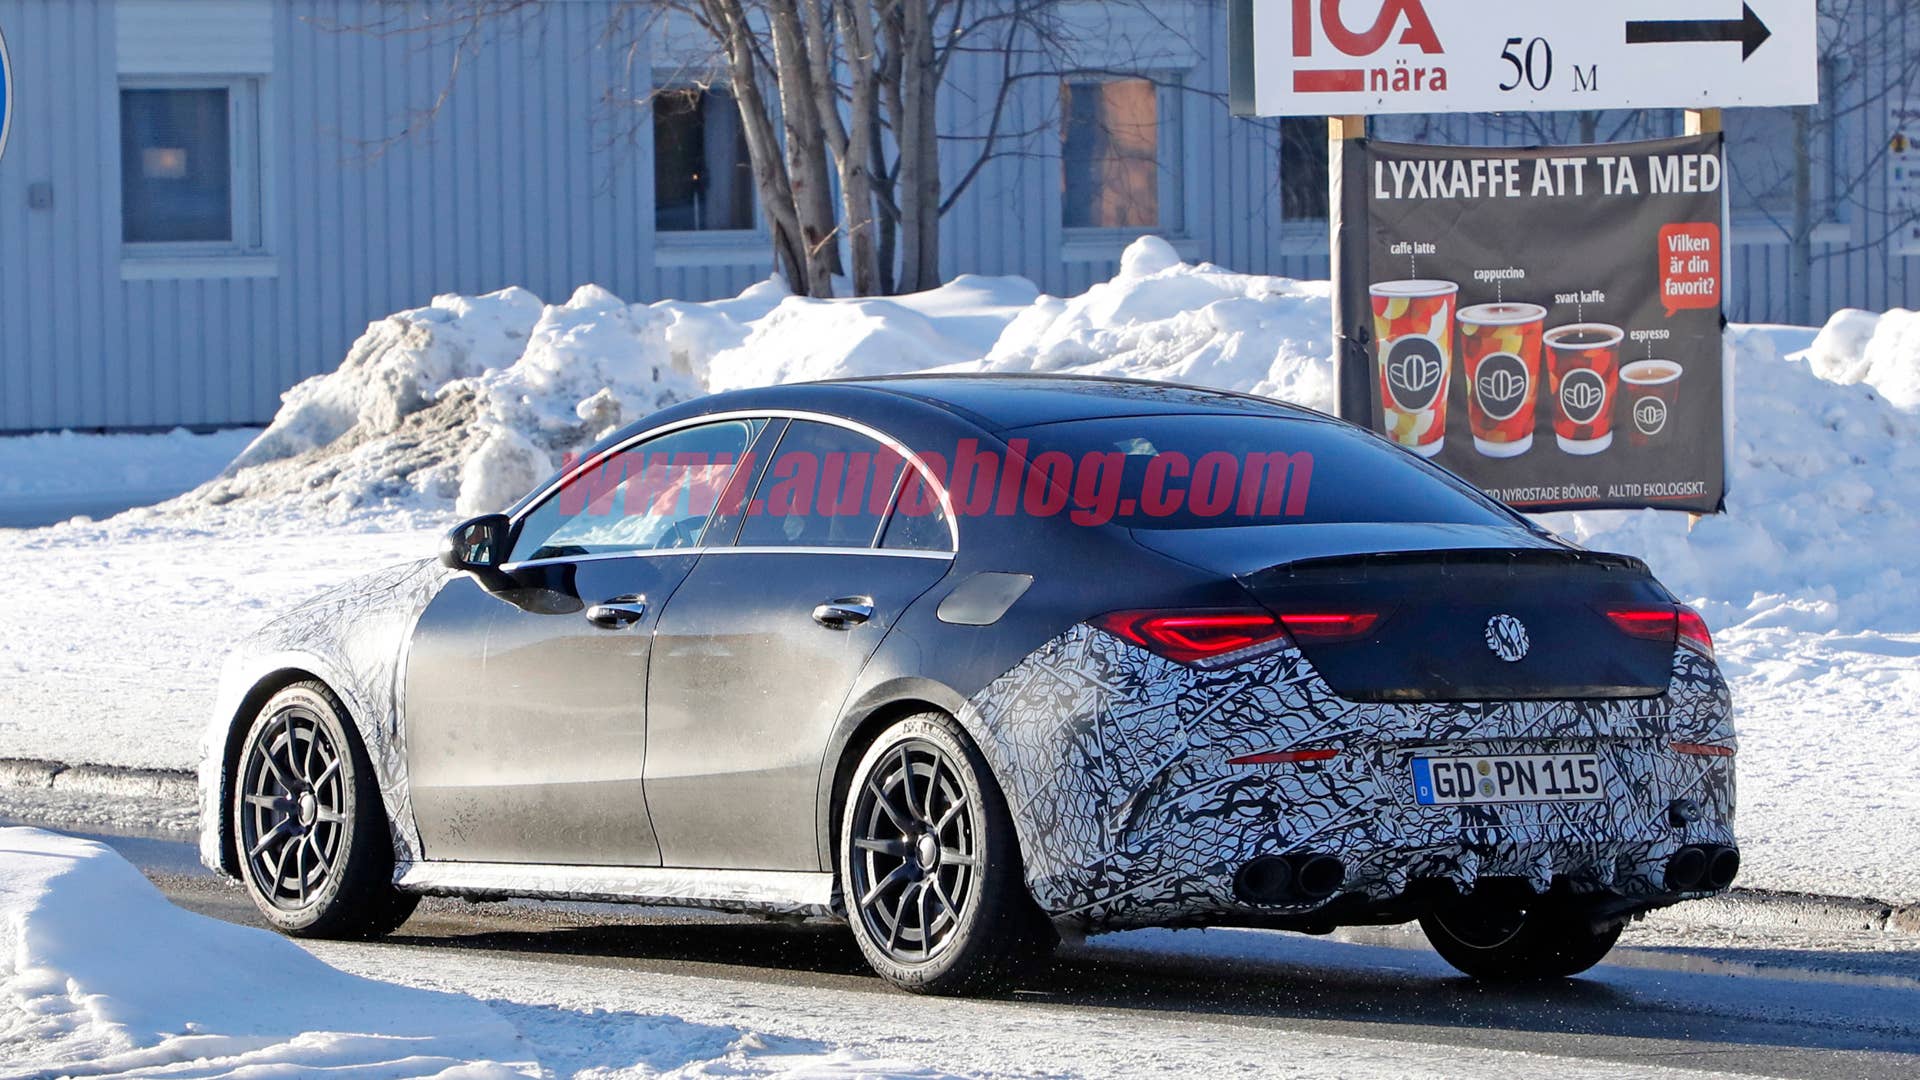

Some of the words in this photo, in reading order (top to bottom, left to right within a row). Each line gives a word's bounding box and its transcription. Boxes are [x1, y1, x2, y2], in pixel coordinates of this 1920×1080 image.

[1292, 0, 1445, 57] ICA
[1499, 37, 1553, 91] 50
[1571, 64, 1599, 92] M
[1369, 59, 1448, 92] nära
[1374, 159, 1521, 199] LYXKAFFE
[1531, 157, 1588, 197] ATT
[1597, 156, 1639, 196] TA
[1649, 153, 1721, 193] MED
[1390, 241, 1413, 255] caffe
[1414, 241, 1436, 255] latte
[1667, 234, 1710, 252] Vilken
[1474, 265, 1525, 282] cappuccino
[1669, 257, 1685, 274] är
[1688, 254, 1710, 274] din
[1664, 275, 1715, 297] favorit?
[1555, 291, 1579, 304] svart
[1580, 290, 1605, 304] kaffe
[1630, 328, 1670, 343] espresso
[1502, 486, 1560, 502] NYROSTADE
[1562, 482, 1601, 499] BÖNOR.
[1608, 483, 1642, 497] ALLTID
[1644, 481, 1708, 496] EKOLOGISKT.
[1433, 763, 1475, 798] GD
[1494, 760, 1538, 796] PN
[1542, 759, 1599, 794] 115
